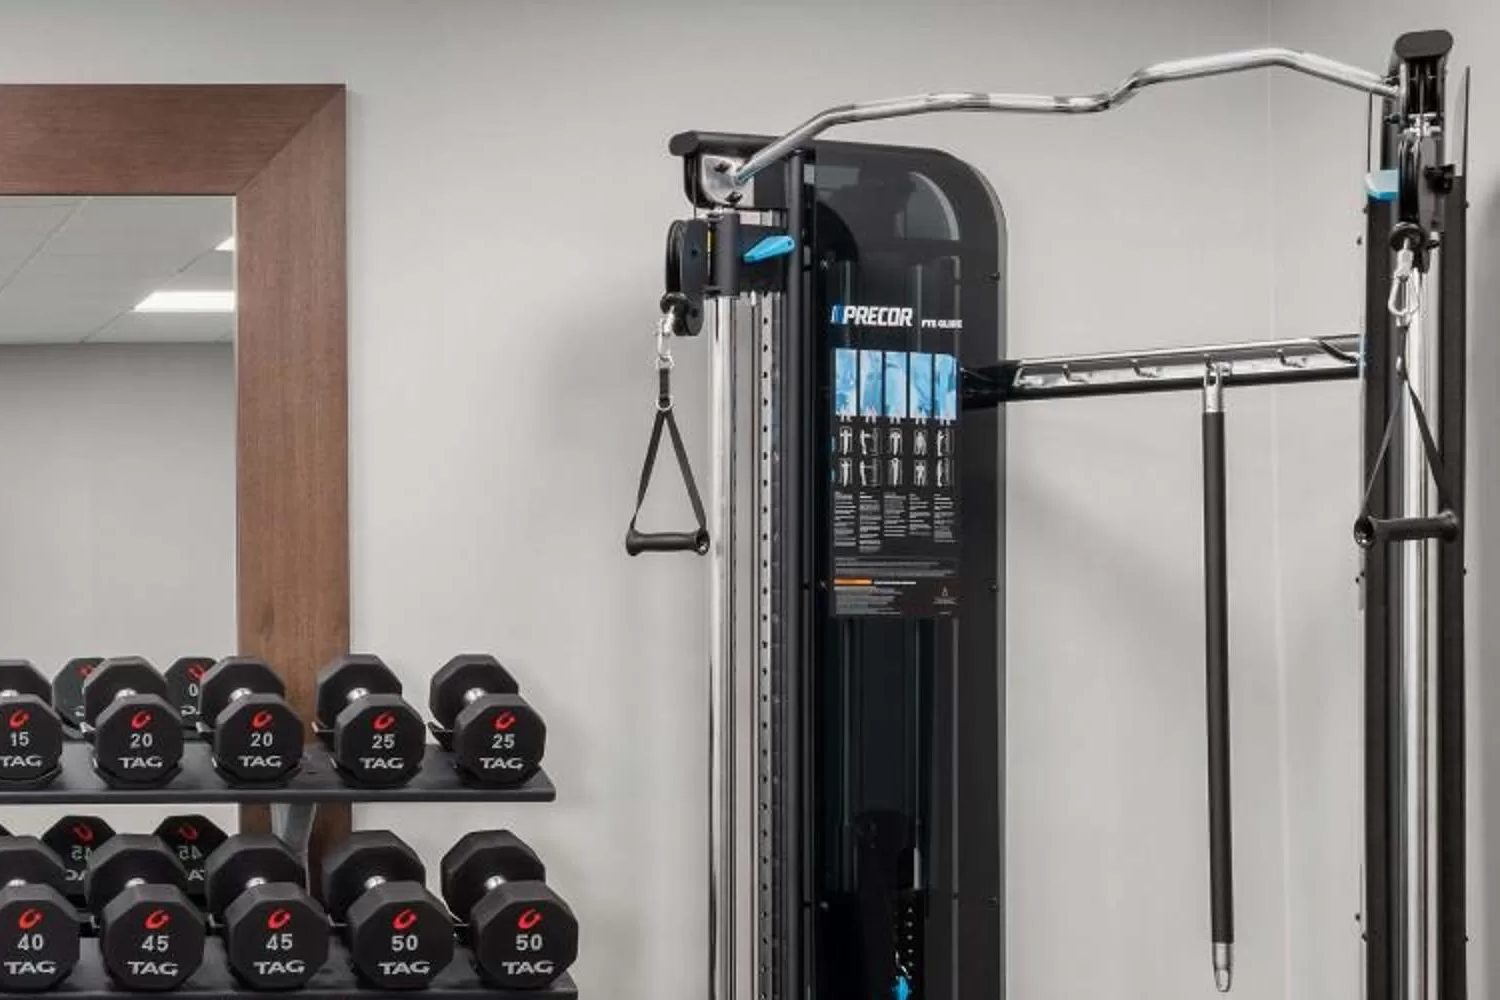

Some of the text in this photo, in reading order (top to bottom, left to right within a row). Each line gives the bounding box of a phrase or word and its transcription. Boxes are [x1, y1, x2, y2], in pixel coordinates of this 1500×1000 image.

[843, 305, 913, 327] PRECOR
[10, 731, 30, 747] 15
[130, 732, 153, 749] 20
[250, 731, 274, 747] 20
[371, 733, 395, 750] 25
[491, 733, 515, 749] 25
[118, 755, 163, 769] TAG
[239, 755, 283, 768] TAG
[359, 757, 405, 769] TAG
[479, 757, 524, 770] TAG
[17, 933, 44, 951] 40
[141, 934, 169, 953] 45
[265, 933, 293, 951] 45
[391, 934, 419, 952] 50
[515, 933, 543, 951] 50
[3, 960, 56, 975] TAG
[127, 961, 179, 977] TAG
[253, 959, 305, 975] TAG
[378, 960, 431, 975] TAG
[501, 959, 554, 975] TAG
